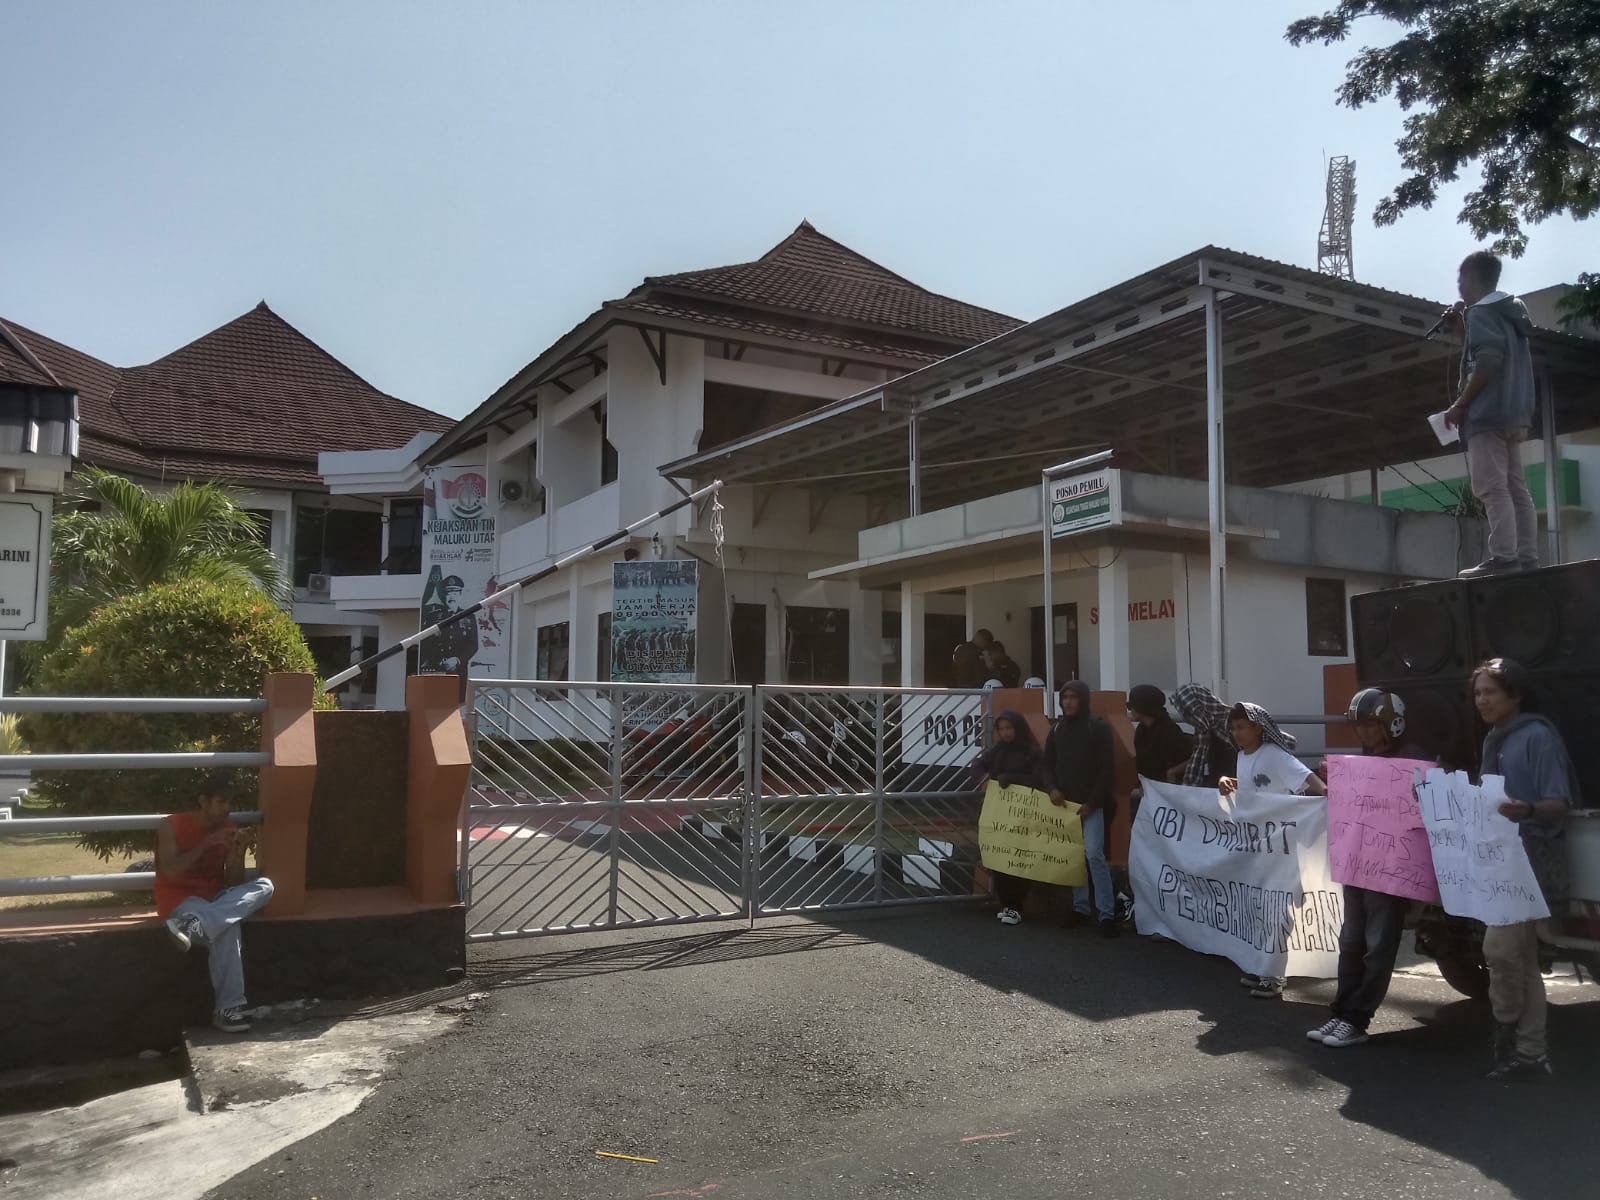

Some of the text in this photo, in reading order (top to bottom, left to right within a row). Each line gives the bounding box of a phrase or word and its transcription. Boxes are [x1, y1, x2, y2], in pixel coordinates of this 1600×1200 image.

[1056, 484, 1078, 500] POSKO
[427, 519, 479, 533] KEJAKSAAN
[434, 533, 471, 545] MALUKU
[924, 714, 957, 746] POS
[1153, 806, 1186, 841] OBI
